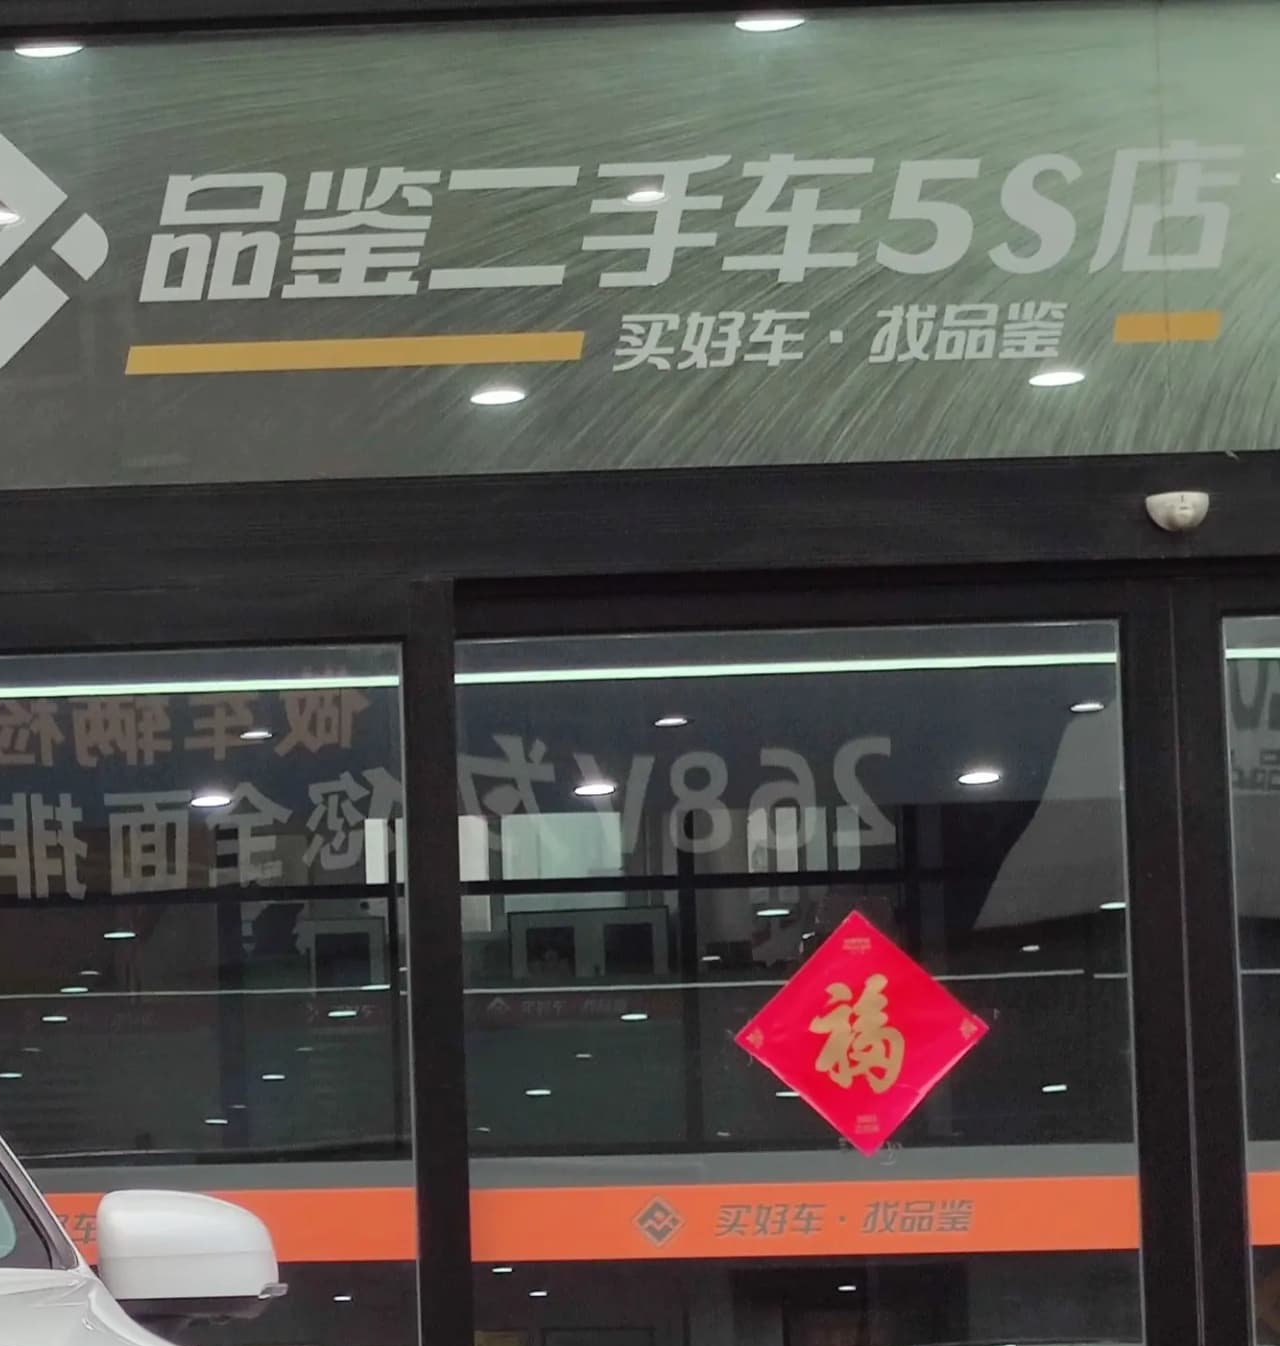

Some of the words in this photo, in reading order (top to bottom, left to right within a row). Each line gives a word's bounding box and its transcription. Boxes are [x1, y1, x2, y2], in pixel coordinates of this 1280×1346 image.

[139, 139, 1245, 303] 品鉴二手车5S店
[809, 973, 906, 1095] 福
